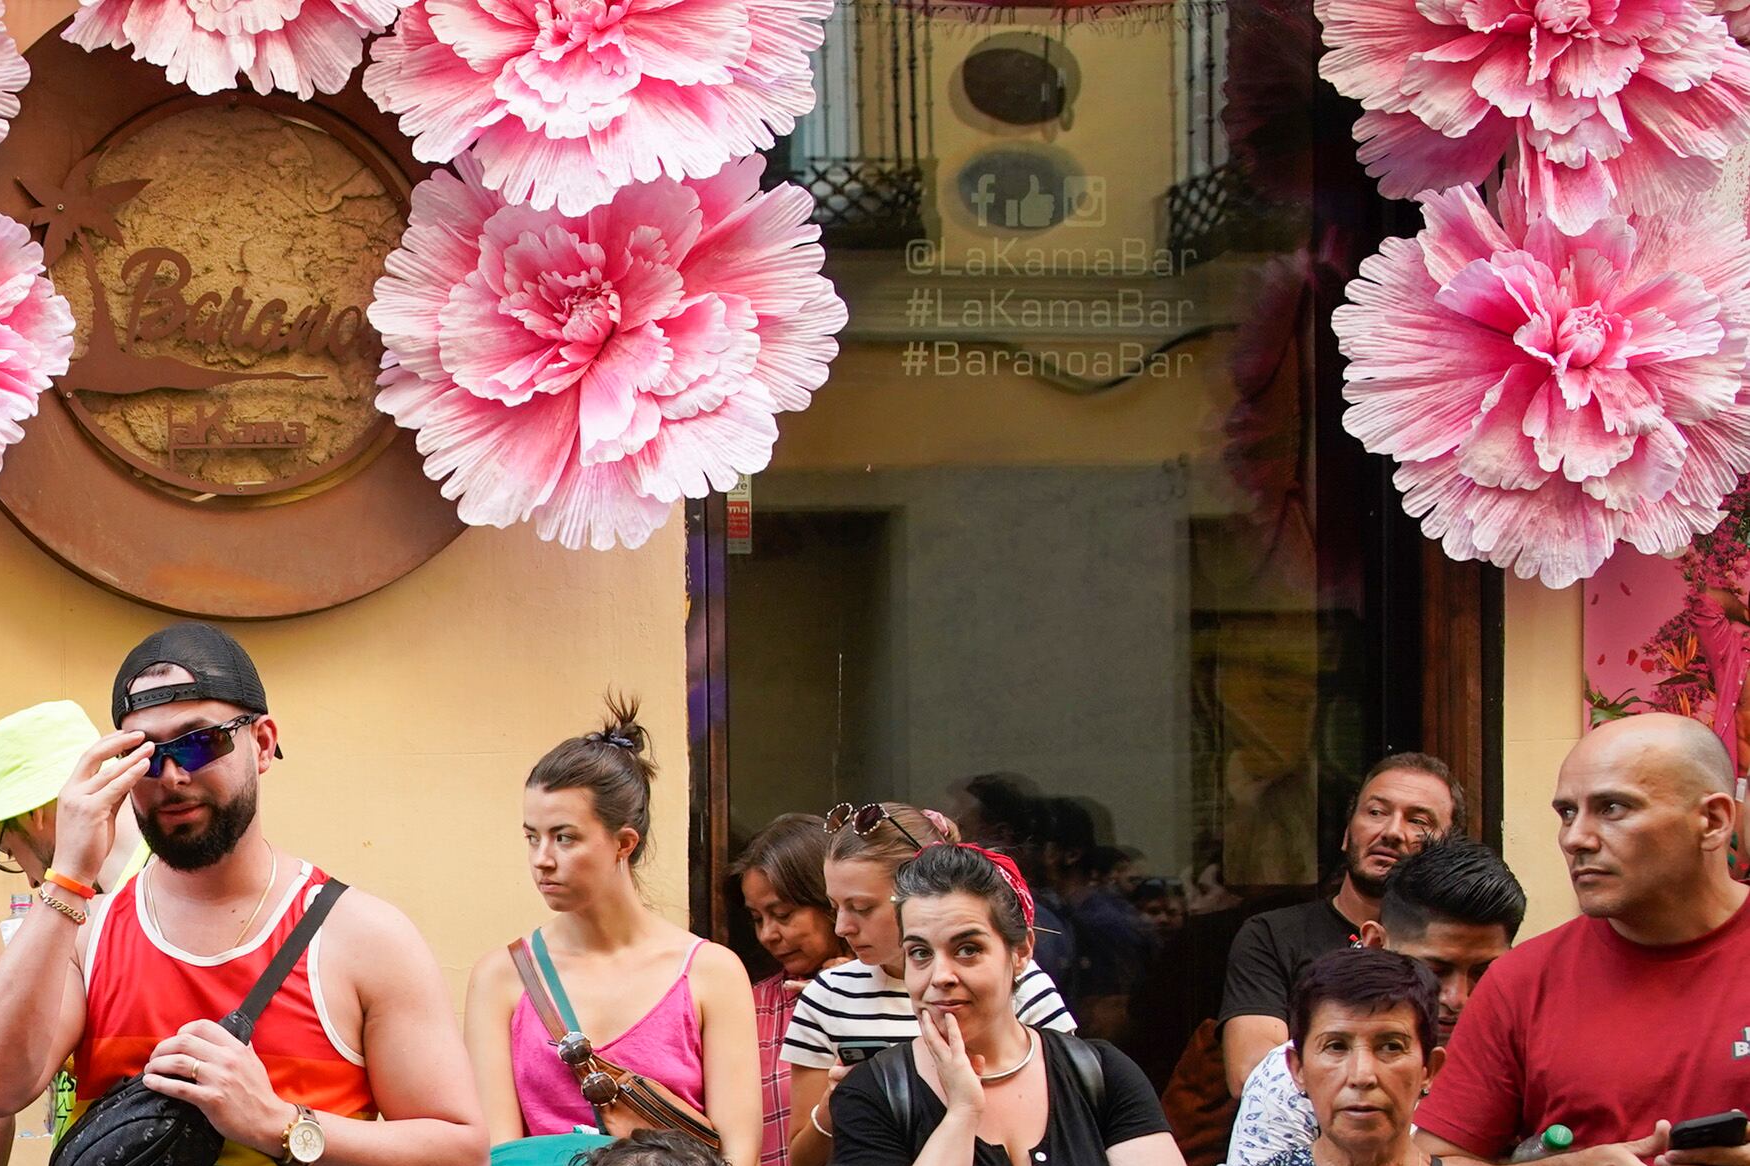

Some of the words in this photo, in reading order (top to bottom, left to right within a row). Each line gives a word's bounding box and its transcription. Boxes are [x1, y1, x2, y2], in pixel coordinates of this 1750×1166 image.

[905, 237, 1197, 276] @LaKamaBar
[121, 247, 382, 354] Barano
[905, 288, 1194, 328] #LaKamaBar
[902, 341, 1194, 378] #BaranoaBar
